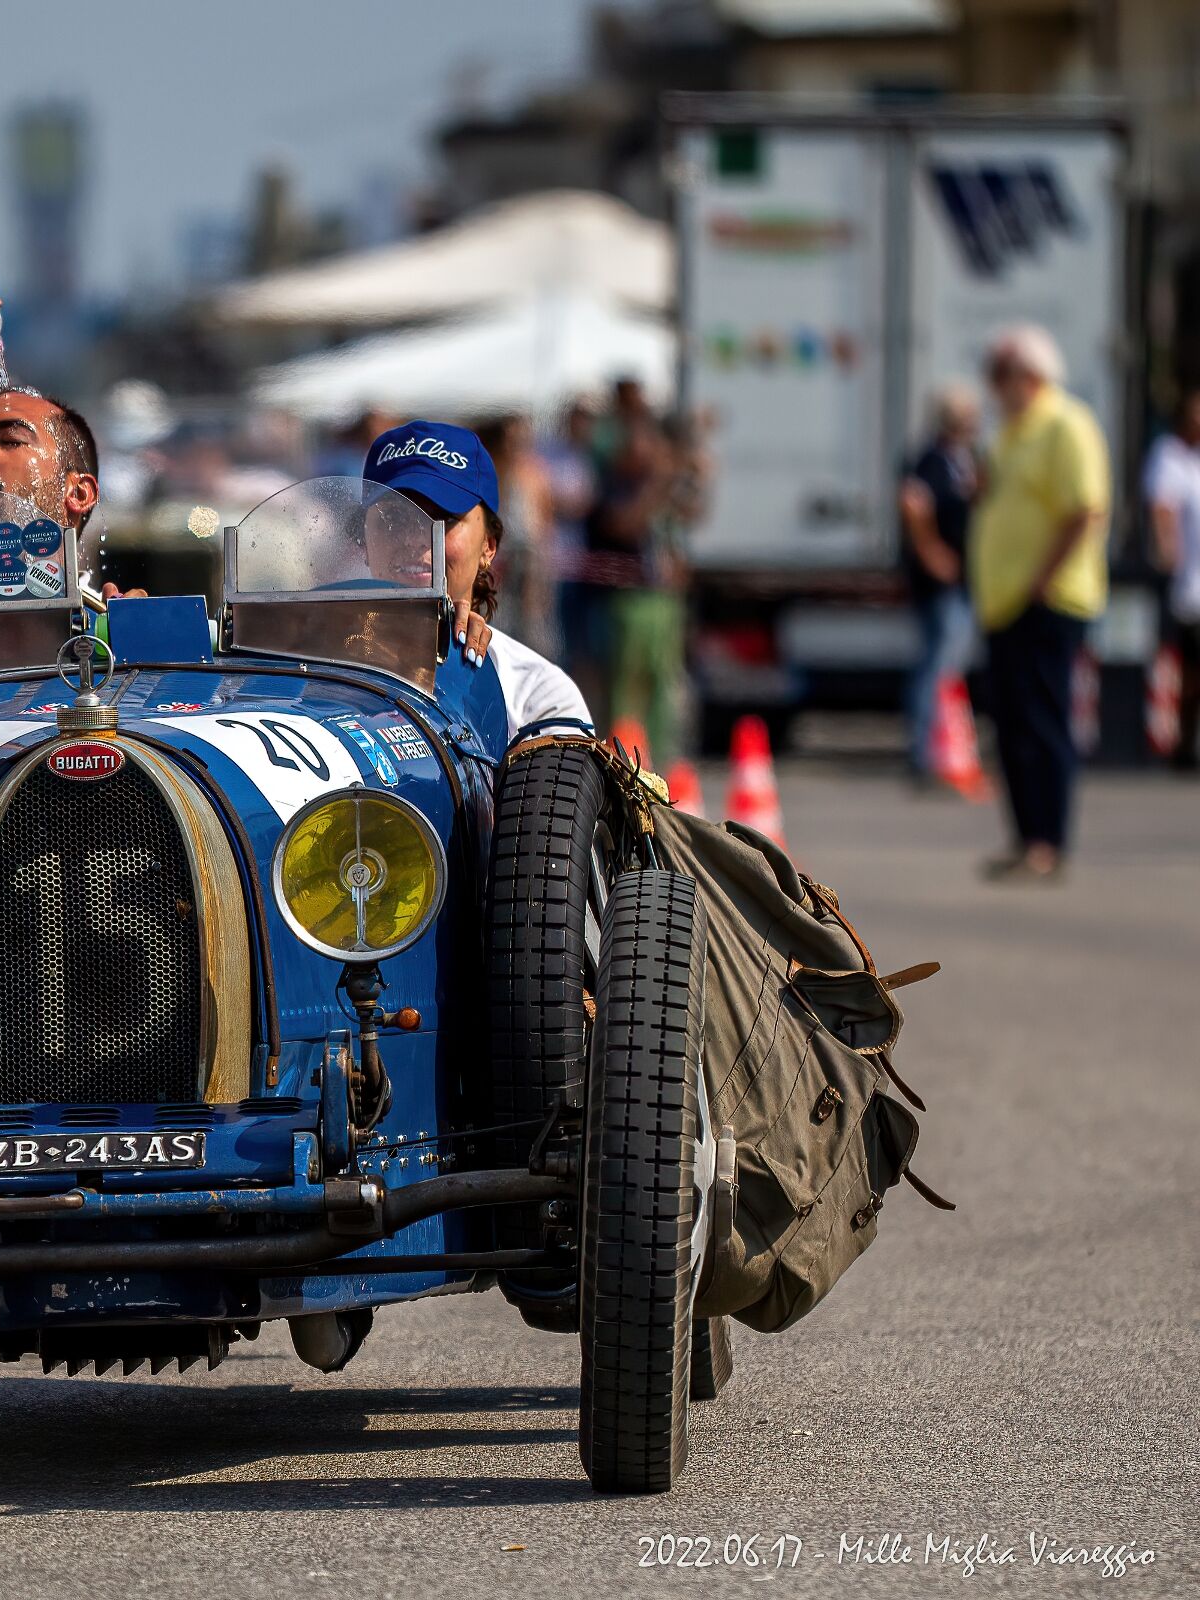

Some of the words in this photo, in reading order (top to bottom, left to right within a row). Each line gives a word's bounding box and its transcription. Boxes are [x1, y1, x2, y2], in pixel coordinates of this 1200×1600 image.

[24, 531, 58, 539] VERIFICATO
[29, 566, 62, 592] VERIFICATO
[55, 755, 115, 770] BUGATTI
[215, 719, 331, 782] 20
[10, 847, 177, 1060] 15
